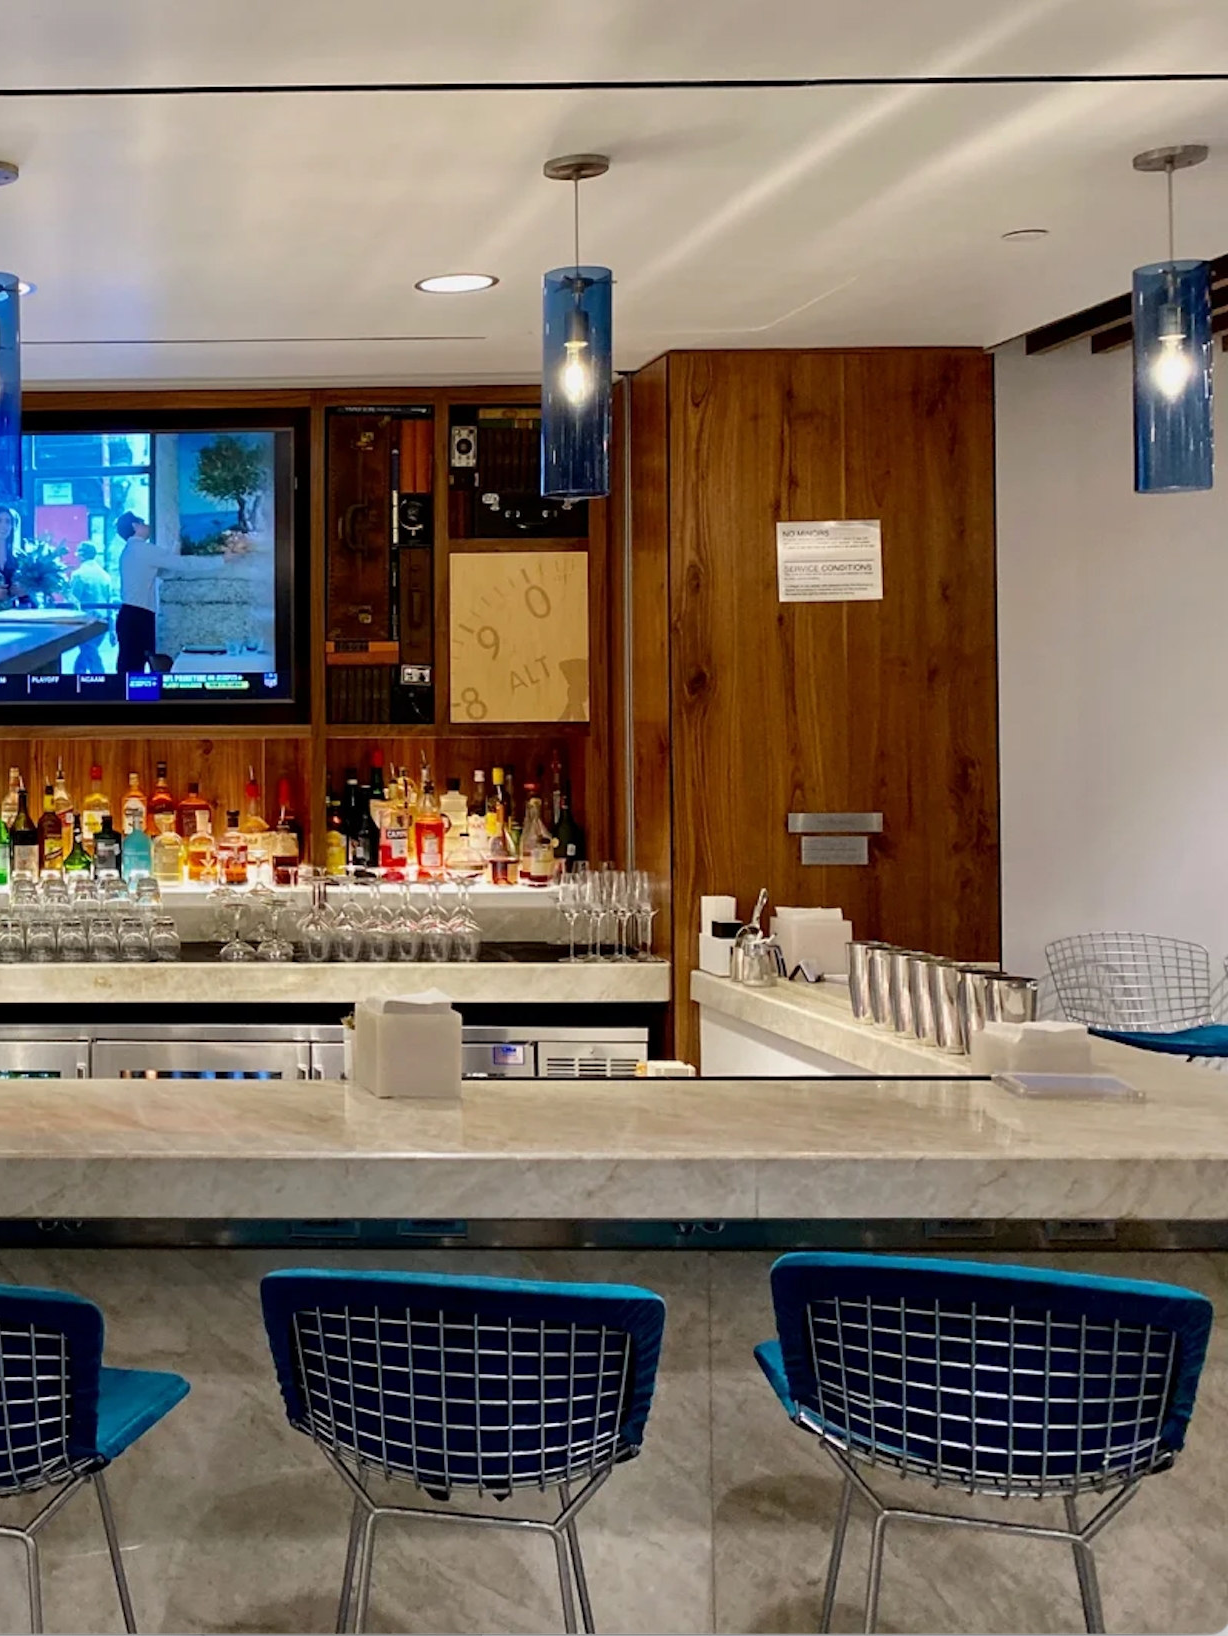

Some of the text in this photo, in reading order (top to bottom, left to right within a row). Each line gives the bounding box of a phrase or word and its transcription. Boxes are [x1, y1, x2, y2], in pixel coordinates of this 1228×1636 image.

[796, 529, 829, 537] MINORS
[783, 563, 873, 573] SERVICE CONDITIONS
[477, 626, 500, 661] 9
[509, 655, 551, 695] ALT
[461, 687, 488, 720] 8
